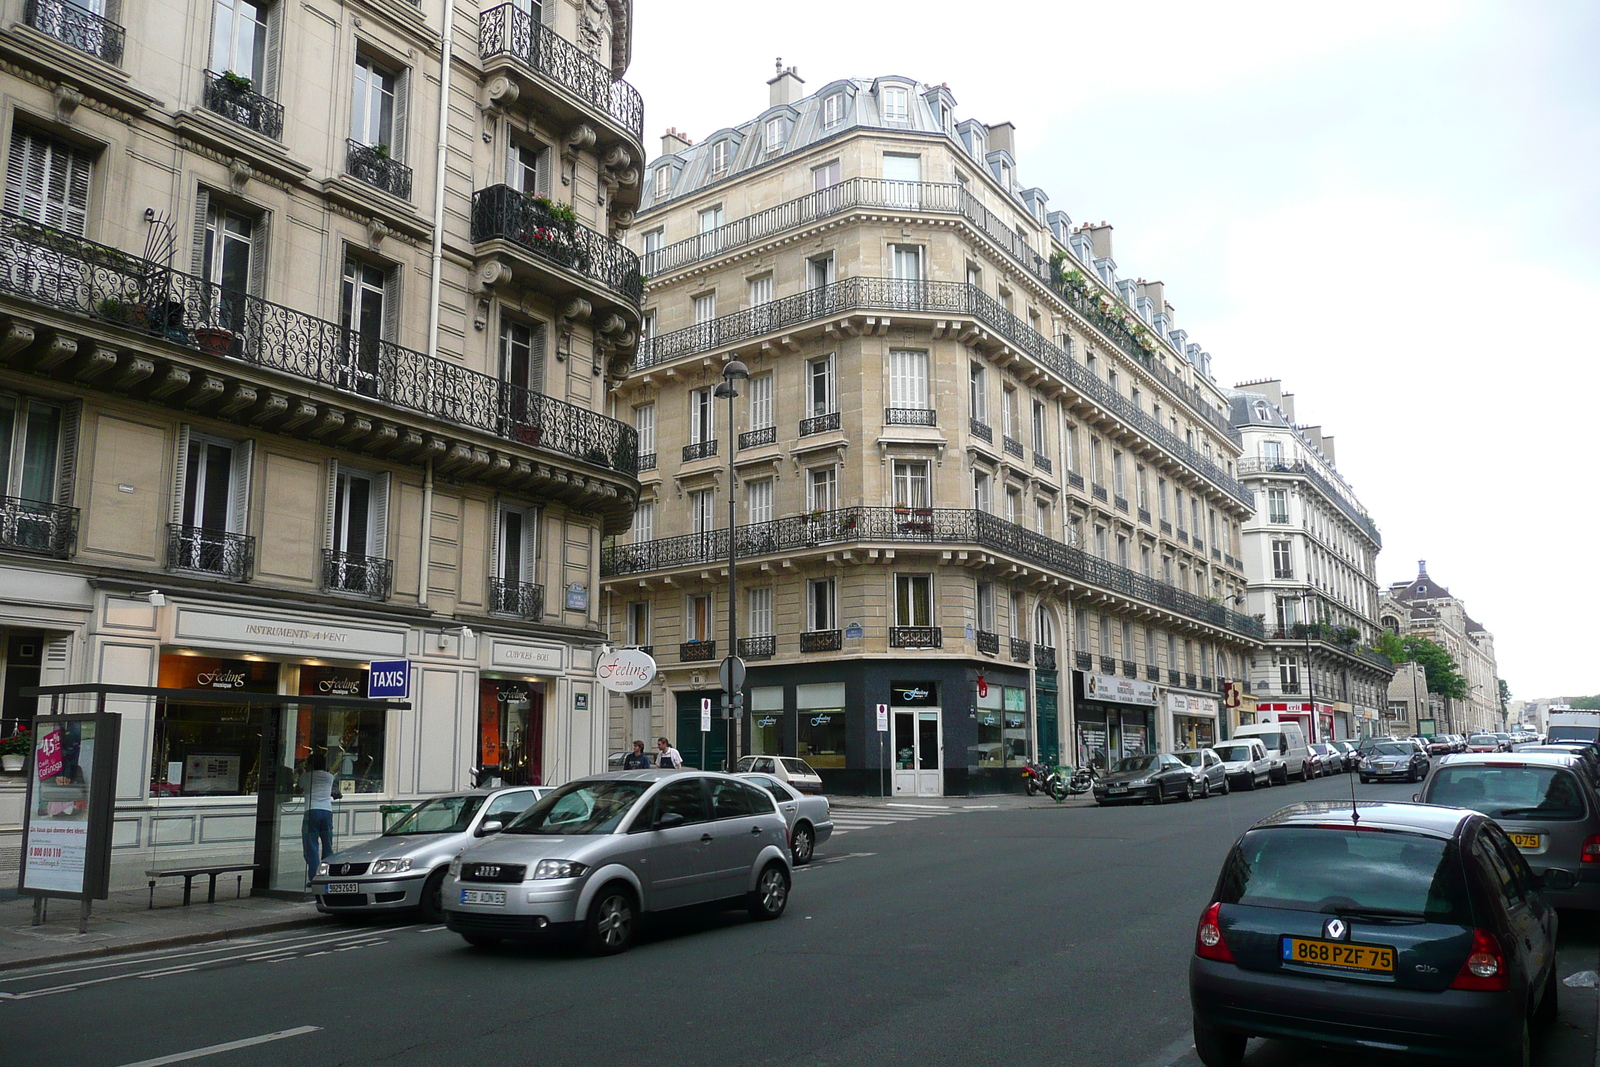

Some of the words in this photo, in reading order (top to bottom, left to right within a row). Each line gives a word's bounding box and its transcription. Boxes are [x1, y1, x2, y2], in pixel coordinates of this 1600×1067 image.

[245, 624, 310, 640] INSTRUMENTS
[323, 632, 347, 643] VENT
[505, 650, 533, 660] CUIVRES
[536, 653, 549, 661] BOIS
[599, 657, 650, 681] Feeling
[372, 670, 404, 688] TAXIS
[1298, 942, 1329, 960] 868
[1333, 946, 1365, 964] PZF
[1369, 950, 1391, 968] 75
